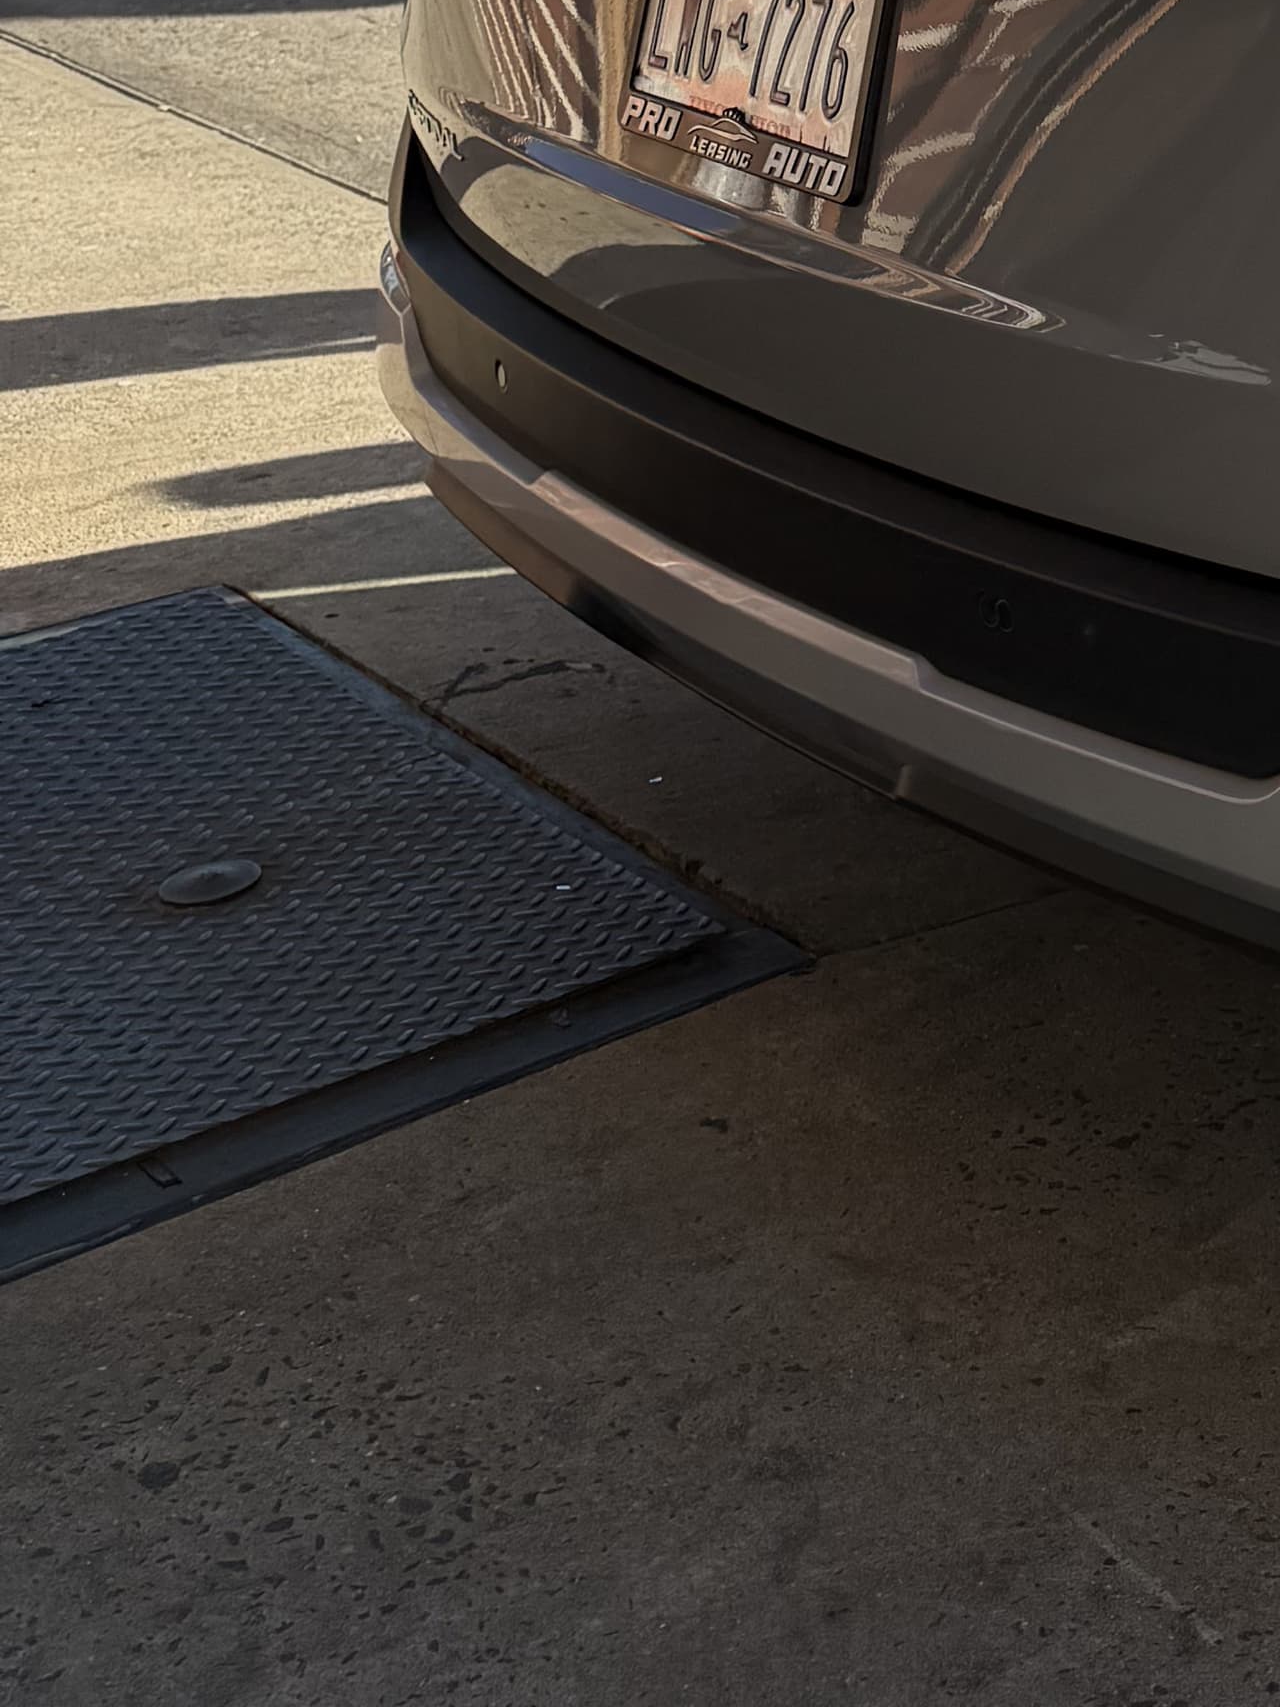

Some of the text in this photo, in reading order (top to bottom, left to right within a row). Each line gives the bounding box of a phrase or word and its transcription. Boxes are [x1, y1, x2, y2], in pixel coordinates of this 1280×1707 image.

[620, 95, 683, 141] PRO
[690, 135, 752, 169] LEASING
[761, 143, 848, 197] AUTO
